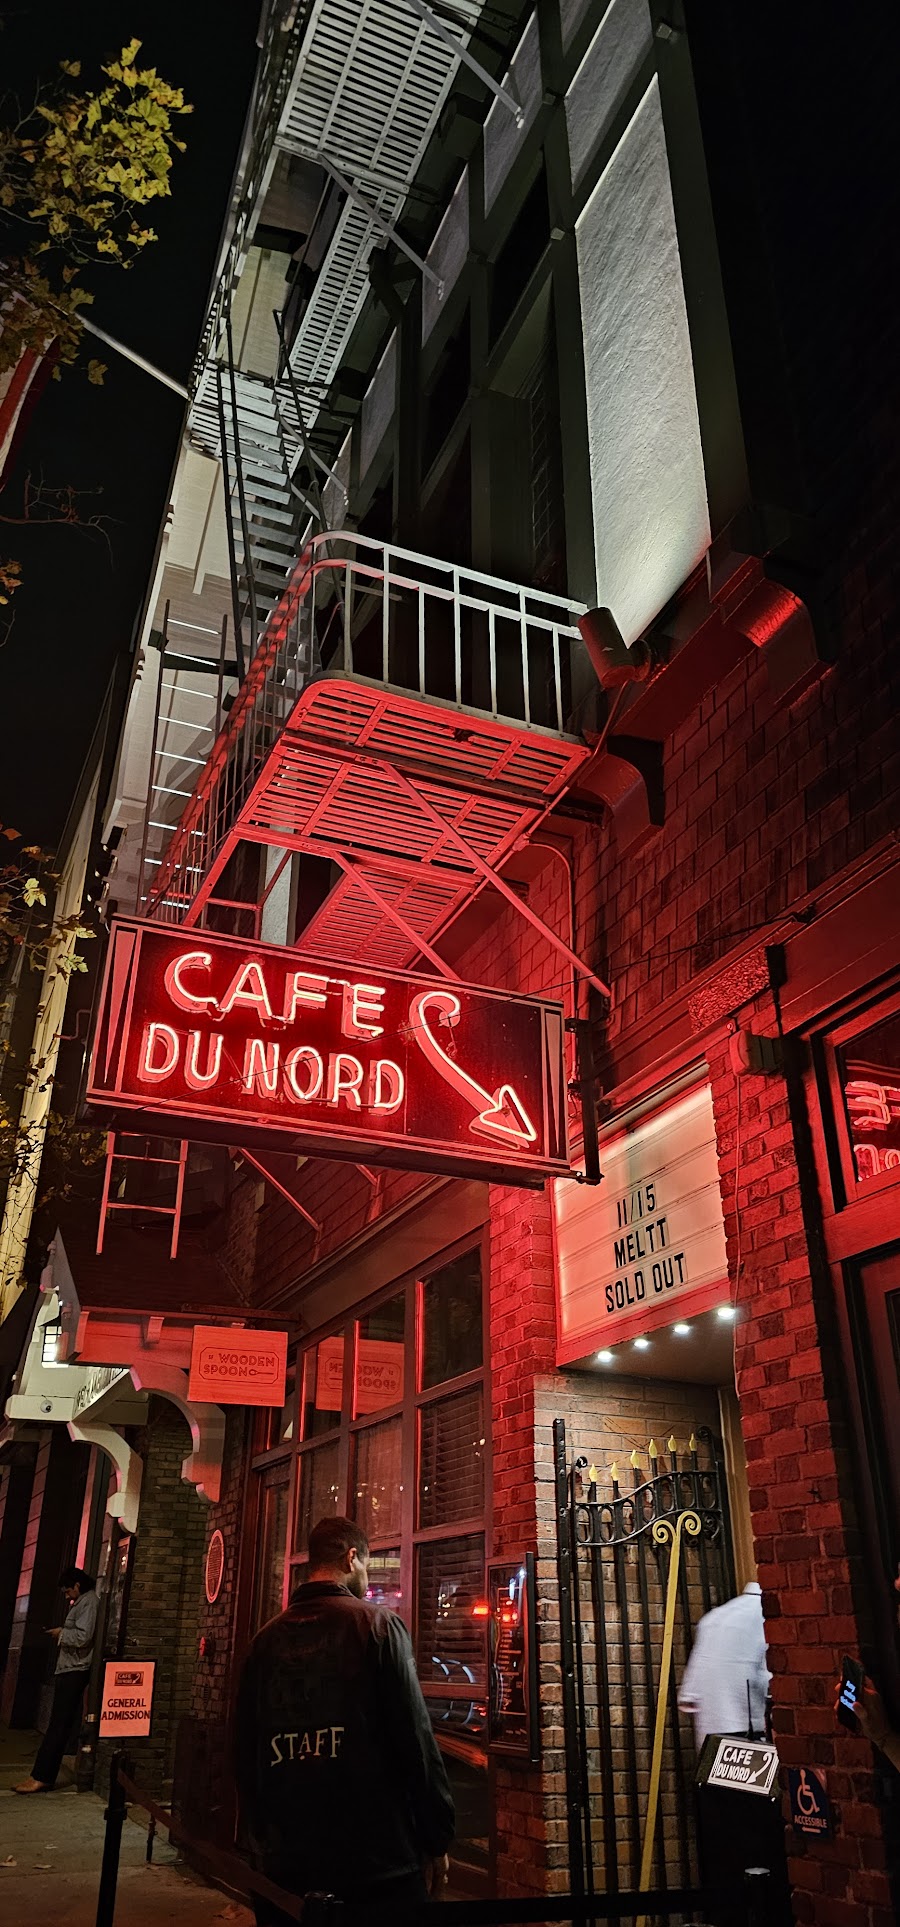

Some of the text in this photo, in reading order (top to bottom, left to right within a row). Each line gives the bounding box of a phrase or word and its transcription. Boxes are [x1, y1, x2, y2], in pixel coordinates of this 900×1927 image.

[164, 951, 386, 1039] CAFE
[138, 1022, 405, 1116] DU NORD
[616, 1184, 657, 1228] 11/15
[613, 1217, 667, 1269] MELTT
[605, 1252, 684, 1313] SOLD OUT
[219, 1353, 275, 1367] WOODEN
[203, 1364, 247, 1377] SPOON
[107, 1698, 147, 1708] GENERAL
[101, 1710, 151, 1721] ADMISSION
[270, 1726, 345, 1767] STAFF
[723, 1746, 754, 1765] CAFE
[716, 1763, 751, 1782] DU NORD
[794, 1815, 828, 1829] ACCESSIBLE
